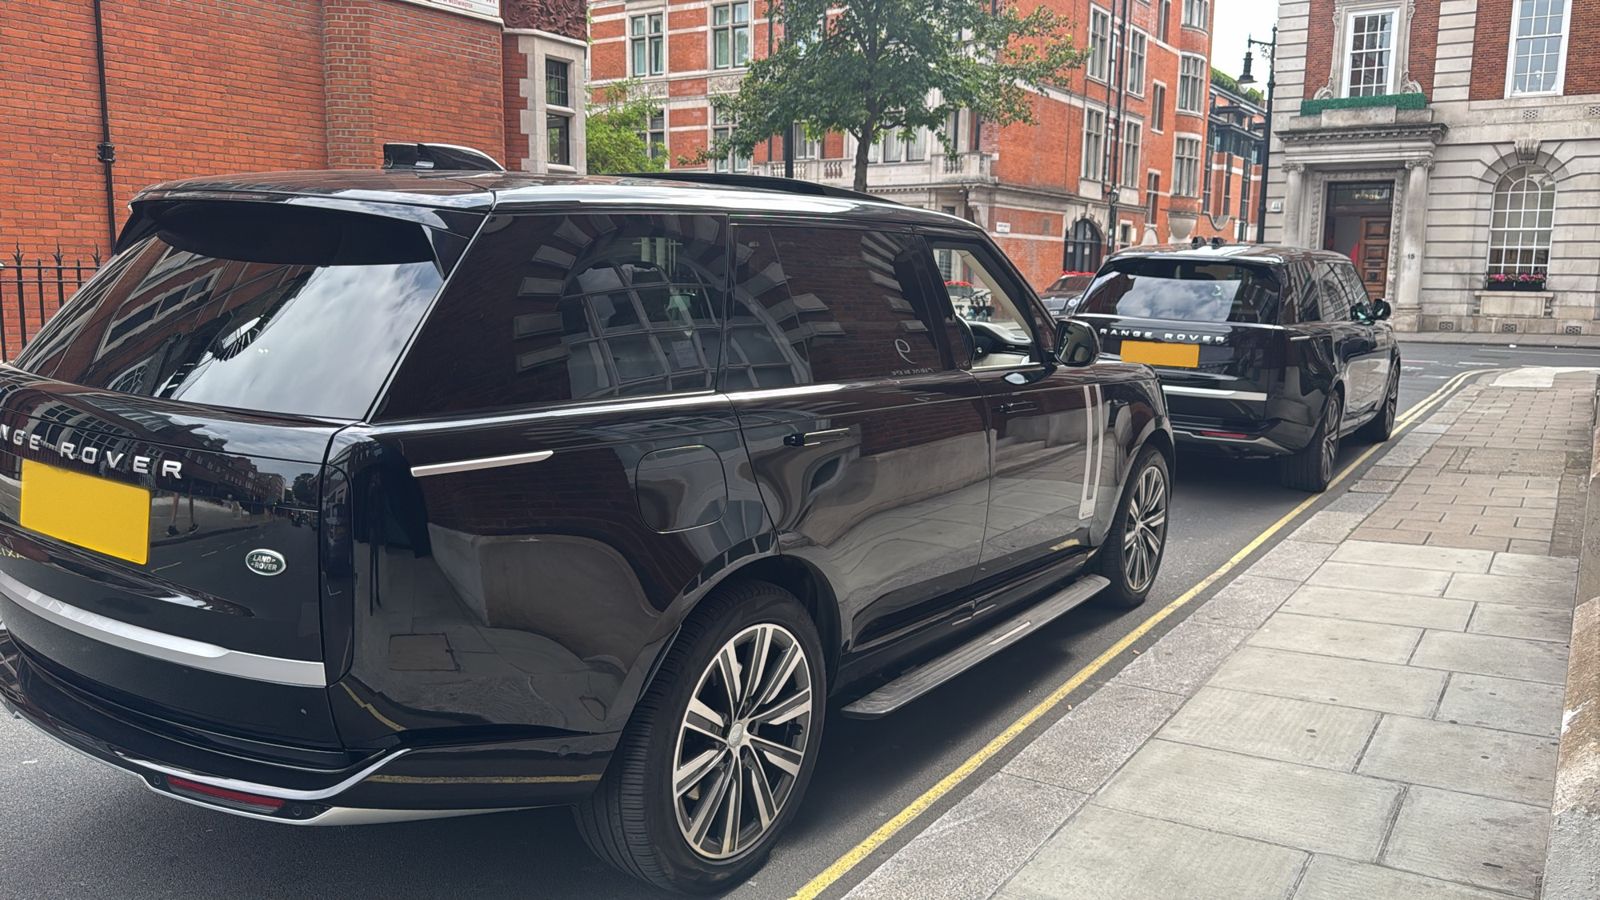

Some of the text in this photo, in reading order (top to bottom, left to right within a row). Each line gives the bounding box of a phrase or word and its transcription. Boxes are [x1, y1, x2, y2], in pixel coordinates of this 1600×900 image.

[1099, 328, 1225, 343] RANGE ROVER
[60, 441, 183, 480] ROVER
[252, 554, 272, 563] LAND
[254, 561, 278, 571] ROVER
